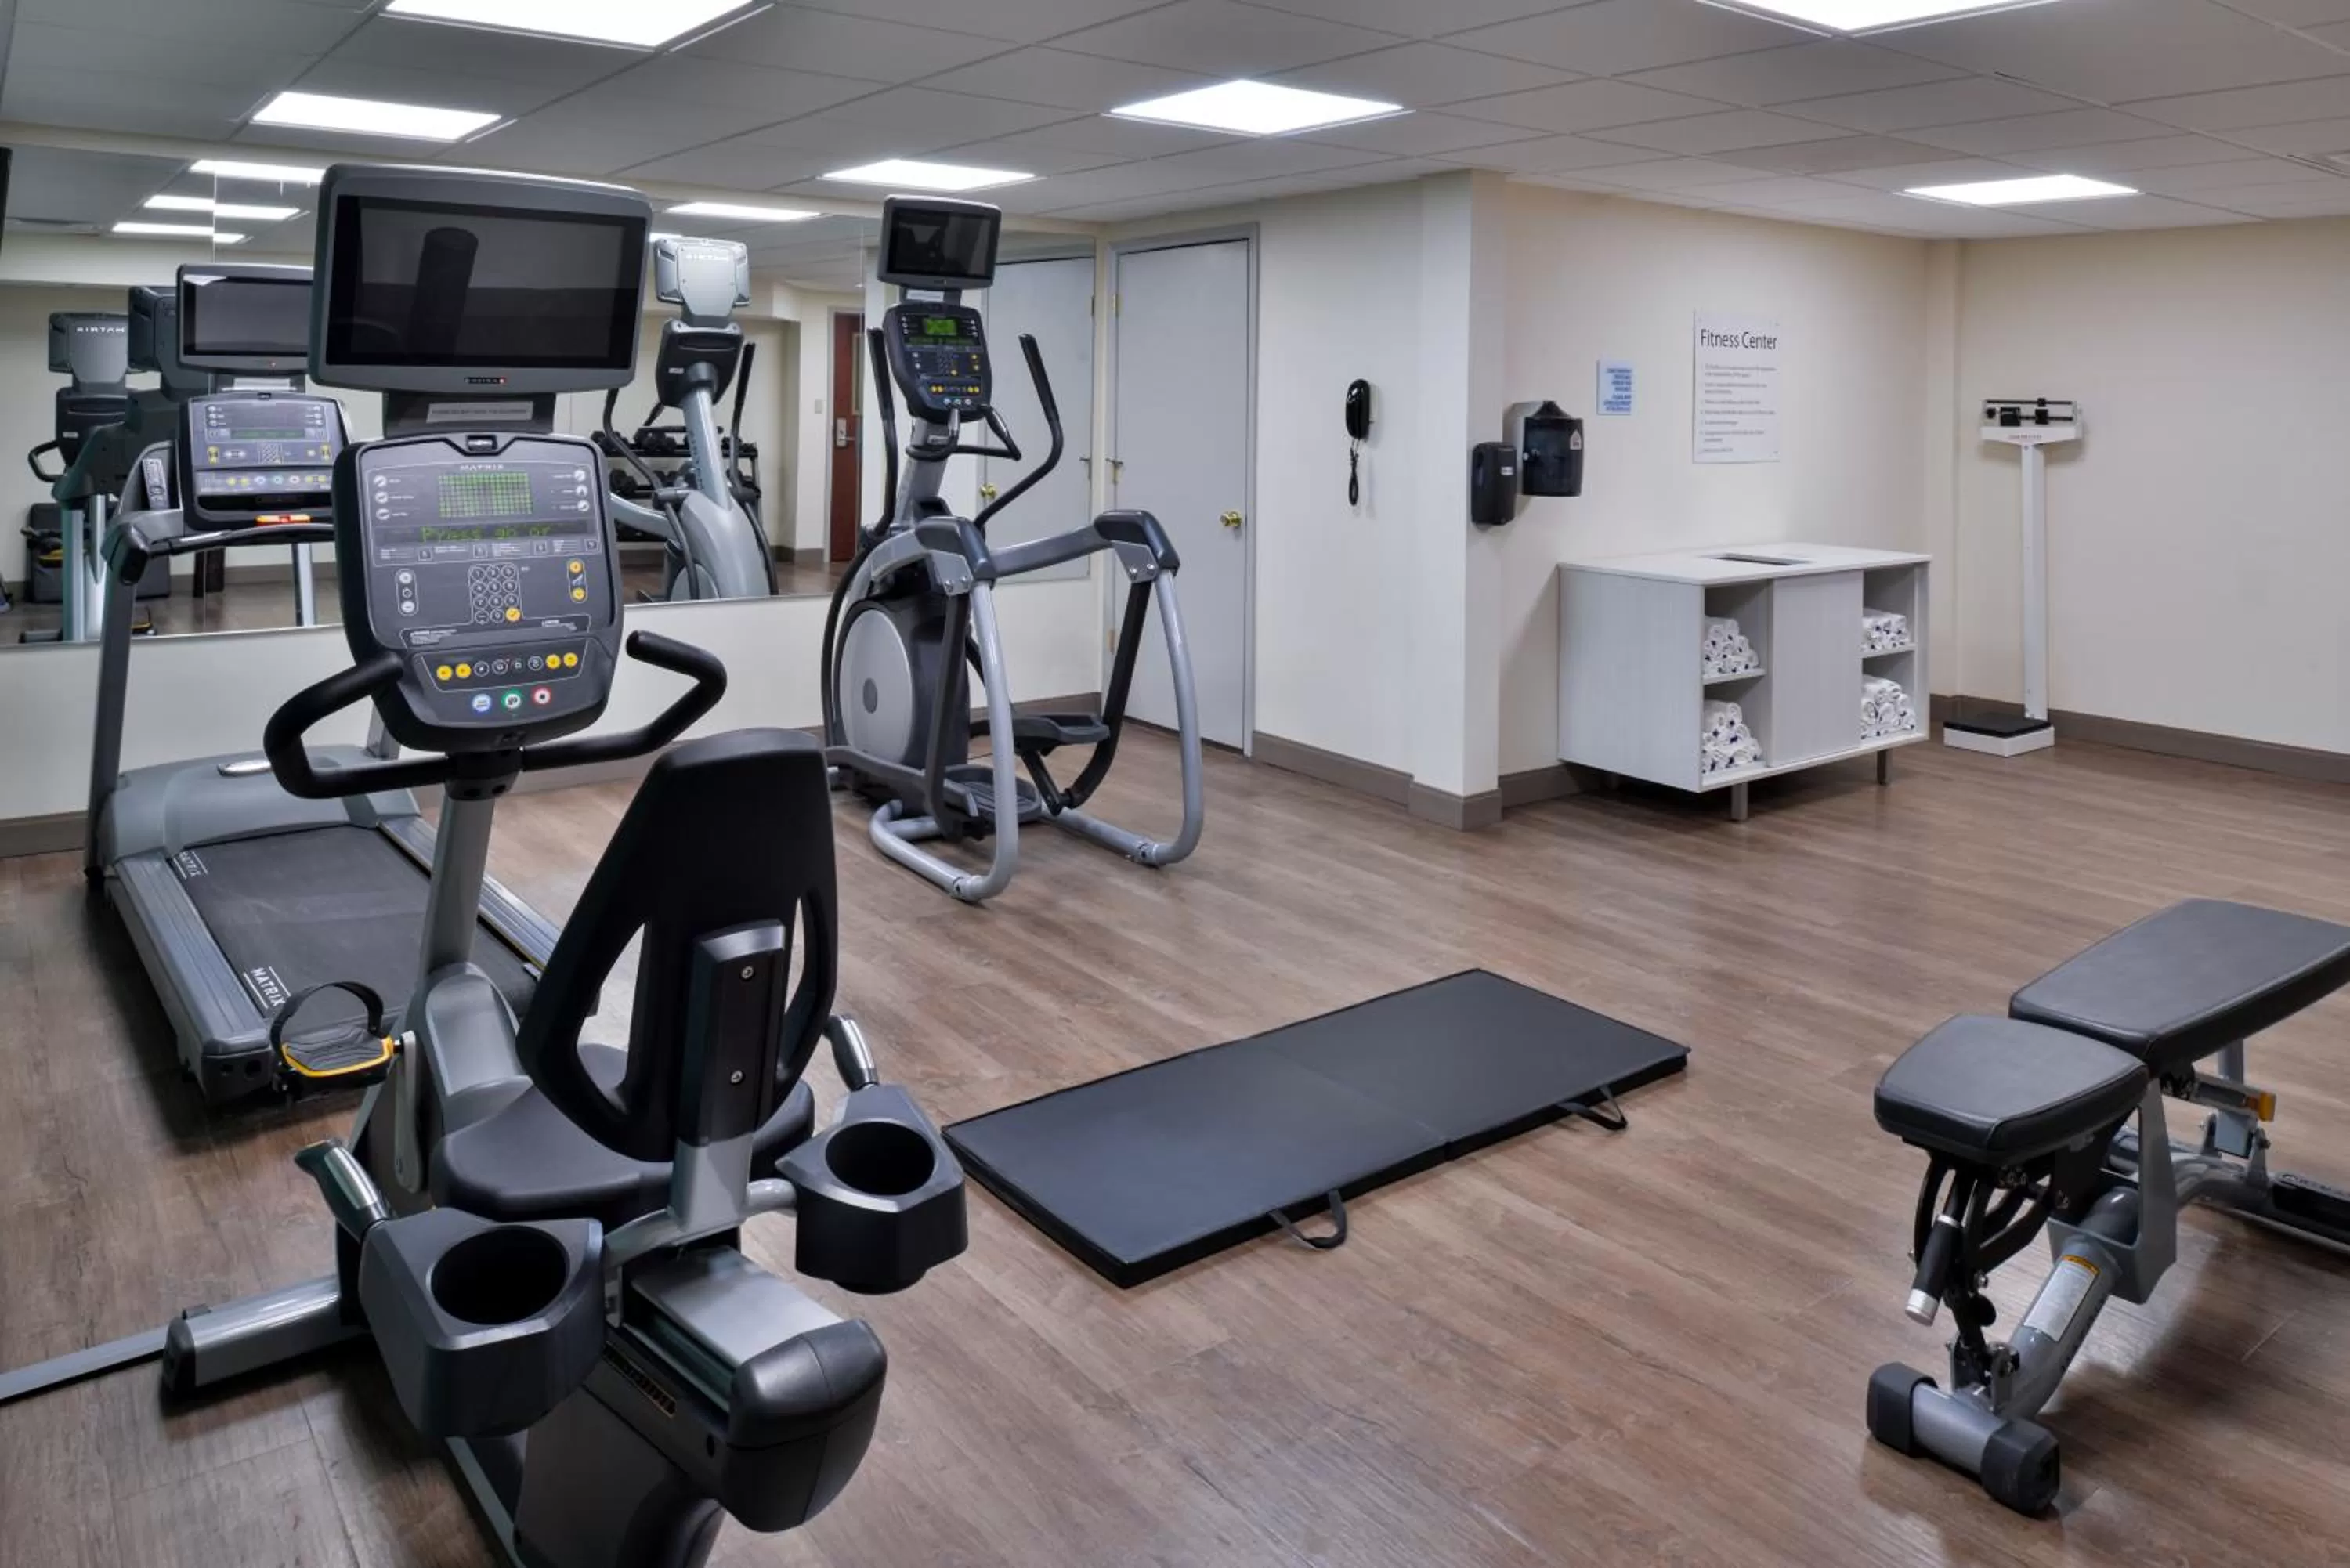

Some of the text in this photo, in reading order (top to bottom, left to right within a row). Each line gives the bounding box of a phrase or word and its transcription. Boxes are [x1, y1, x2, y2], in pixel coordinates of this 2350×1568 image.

[1701, 328, 1777, 349] Fitness Center
[251, 967, 286, 1006] MATRIX
